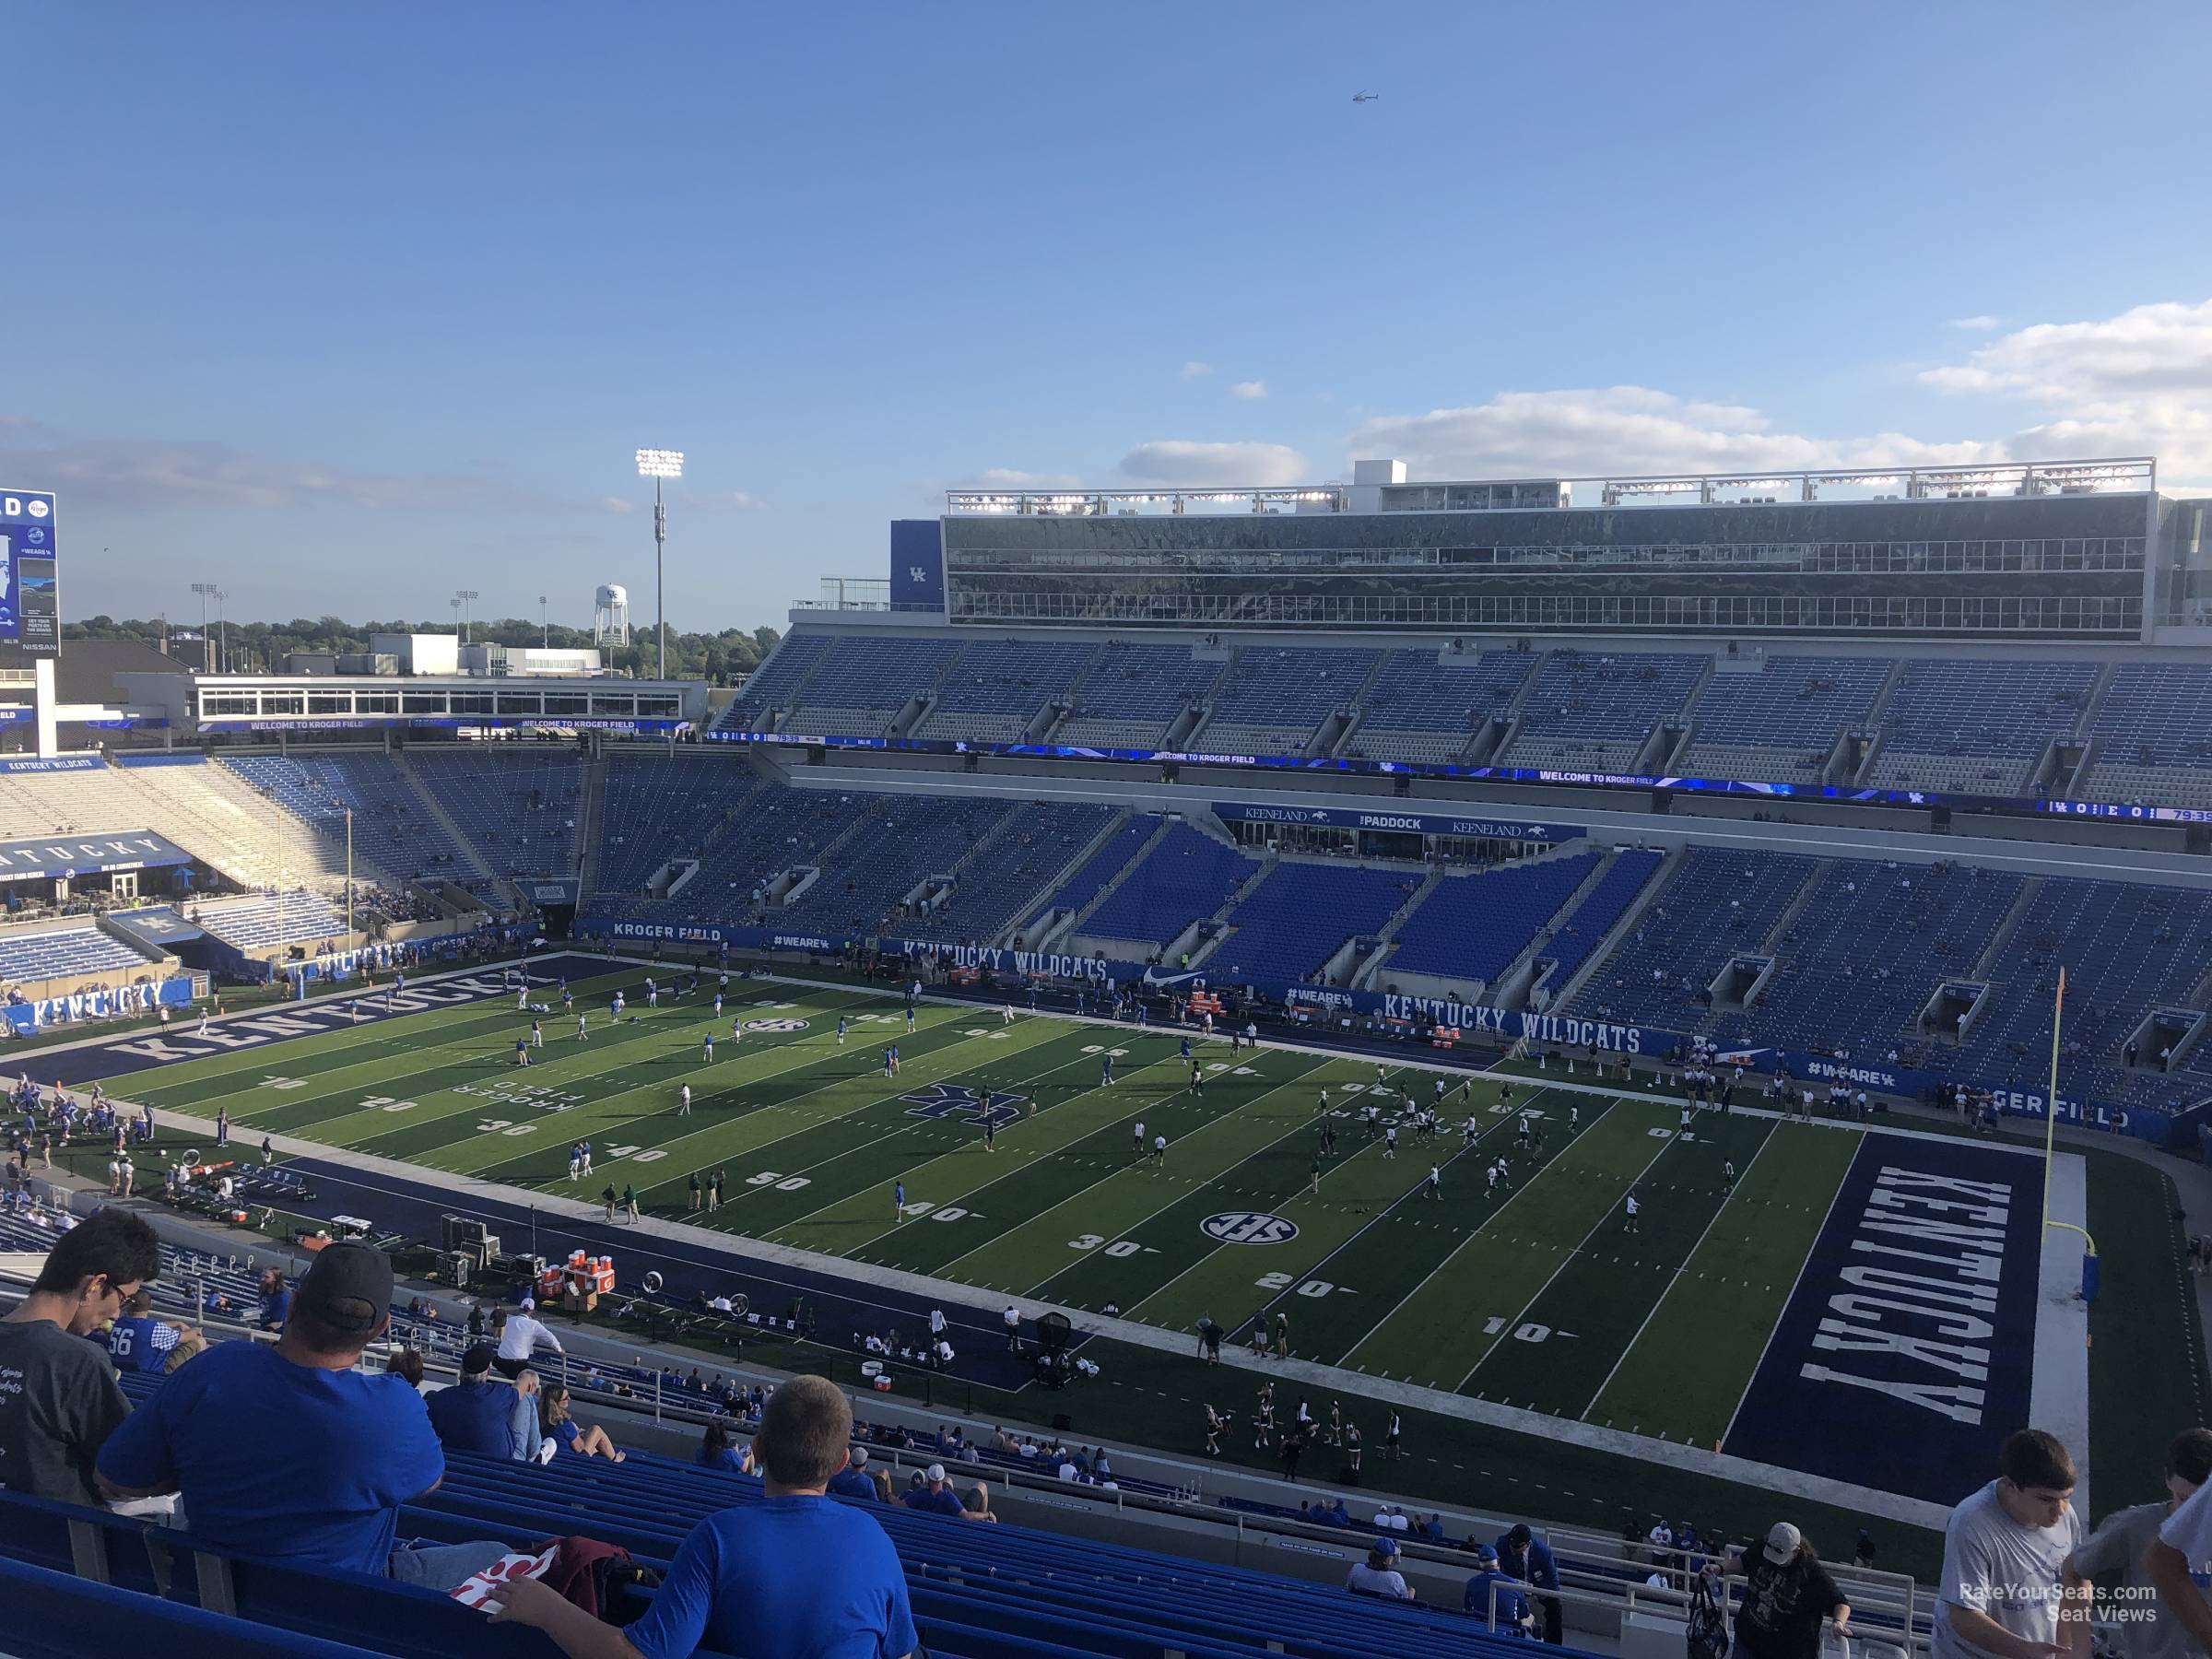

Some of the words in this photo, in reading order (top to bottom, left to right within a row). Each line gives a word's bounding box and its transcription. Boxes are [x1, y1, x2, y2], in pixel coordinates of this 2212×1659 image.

[0, 497, 20, 516] D
[910, 567, 926, 582] UK
[251, 721, 294, 730] WELCOME
[296, 721, 308, 729] TO
[309, 720, 342, 729] KROGER
[343, 720, 363, 728] FIELD
[8, 762, 52, 771] KENTUCKY
[53, 759, 93, 769] WILDCATS
[1155, 752, 1187, 760] WELCOME
[1189, 753, 1198, 761] TO
[1199, 754, 1230, 763] KROGER
[1231, 756, 1255, 764] FIELD
[1539, 771, 1591, 782] WELCOME
[1593, 773, 1605, 782] TO
[1606, 775, 1636, 784] KROGER
[1245, 807, 1307, 821] KEENELAND
[1364, 816, 1421, 830] PADDOCK
[1453, 821, 1521, 837] KEENELAND
[614, 923, 674, 938] KROGER
[678, 928, 721, 941] FIELD
[1014, 950, 1107, 982] WILDCATS
[104, 971, 559, 1062] KENTUCKY
[1385, 994, 1506, 1031] KENTUCKY
[1521, 1012, 1641, 1054] WILDCATS
[359, 1097, 418, 1112] 20
[1992, 1089, 2043, 1113] GER
[477, 1119, 537, 1136] 30
[605, 1145, 668, 1162] 40
[745, 1171, 811, 1191] 50
[901, 1201, 967, 1222] 40
[1067, 1233, 1141, 1257] 30
[1254, 1271, 1335, 1298] 20
[1799, 1165, 2012, 1426] KENTUCKY
[1481, 1314, 1552, 1344] 10
